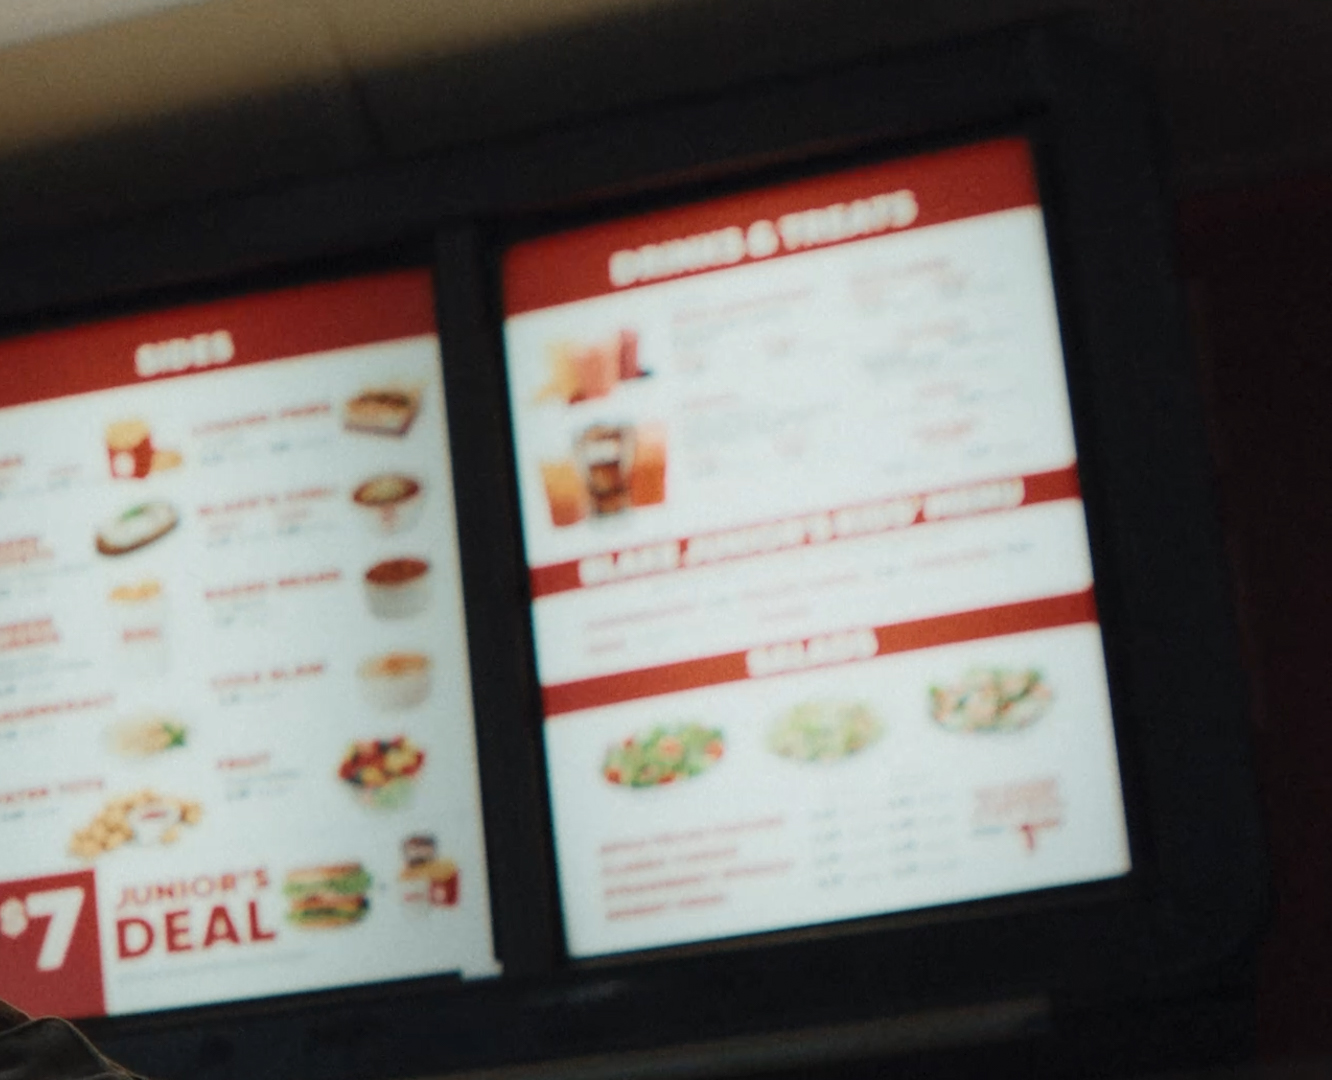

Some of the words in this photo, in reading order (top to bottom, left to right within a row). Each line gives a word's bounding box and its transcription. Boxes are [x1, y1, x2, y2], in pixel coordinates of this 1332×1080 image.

[136, 329, 233, 378] SIDES
[117, 868, 270, 909] JUNIOR'S
[116, 899, 278, 961] DEAL
